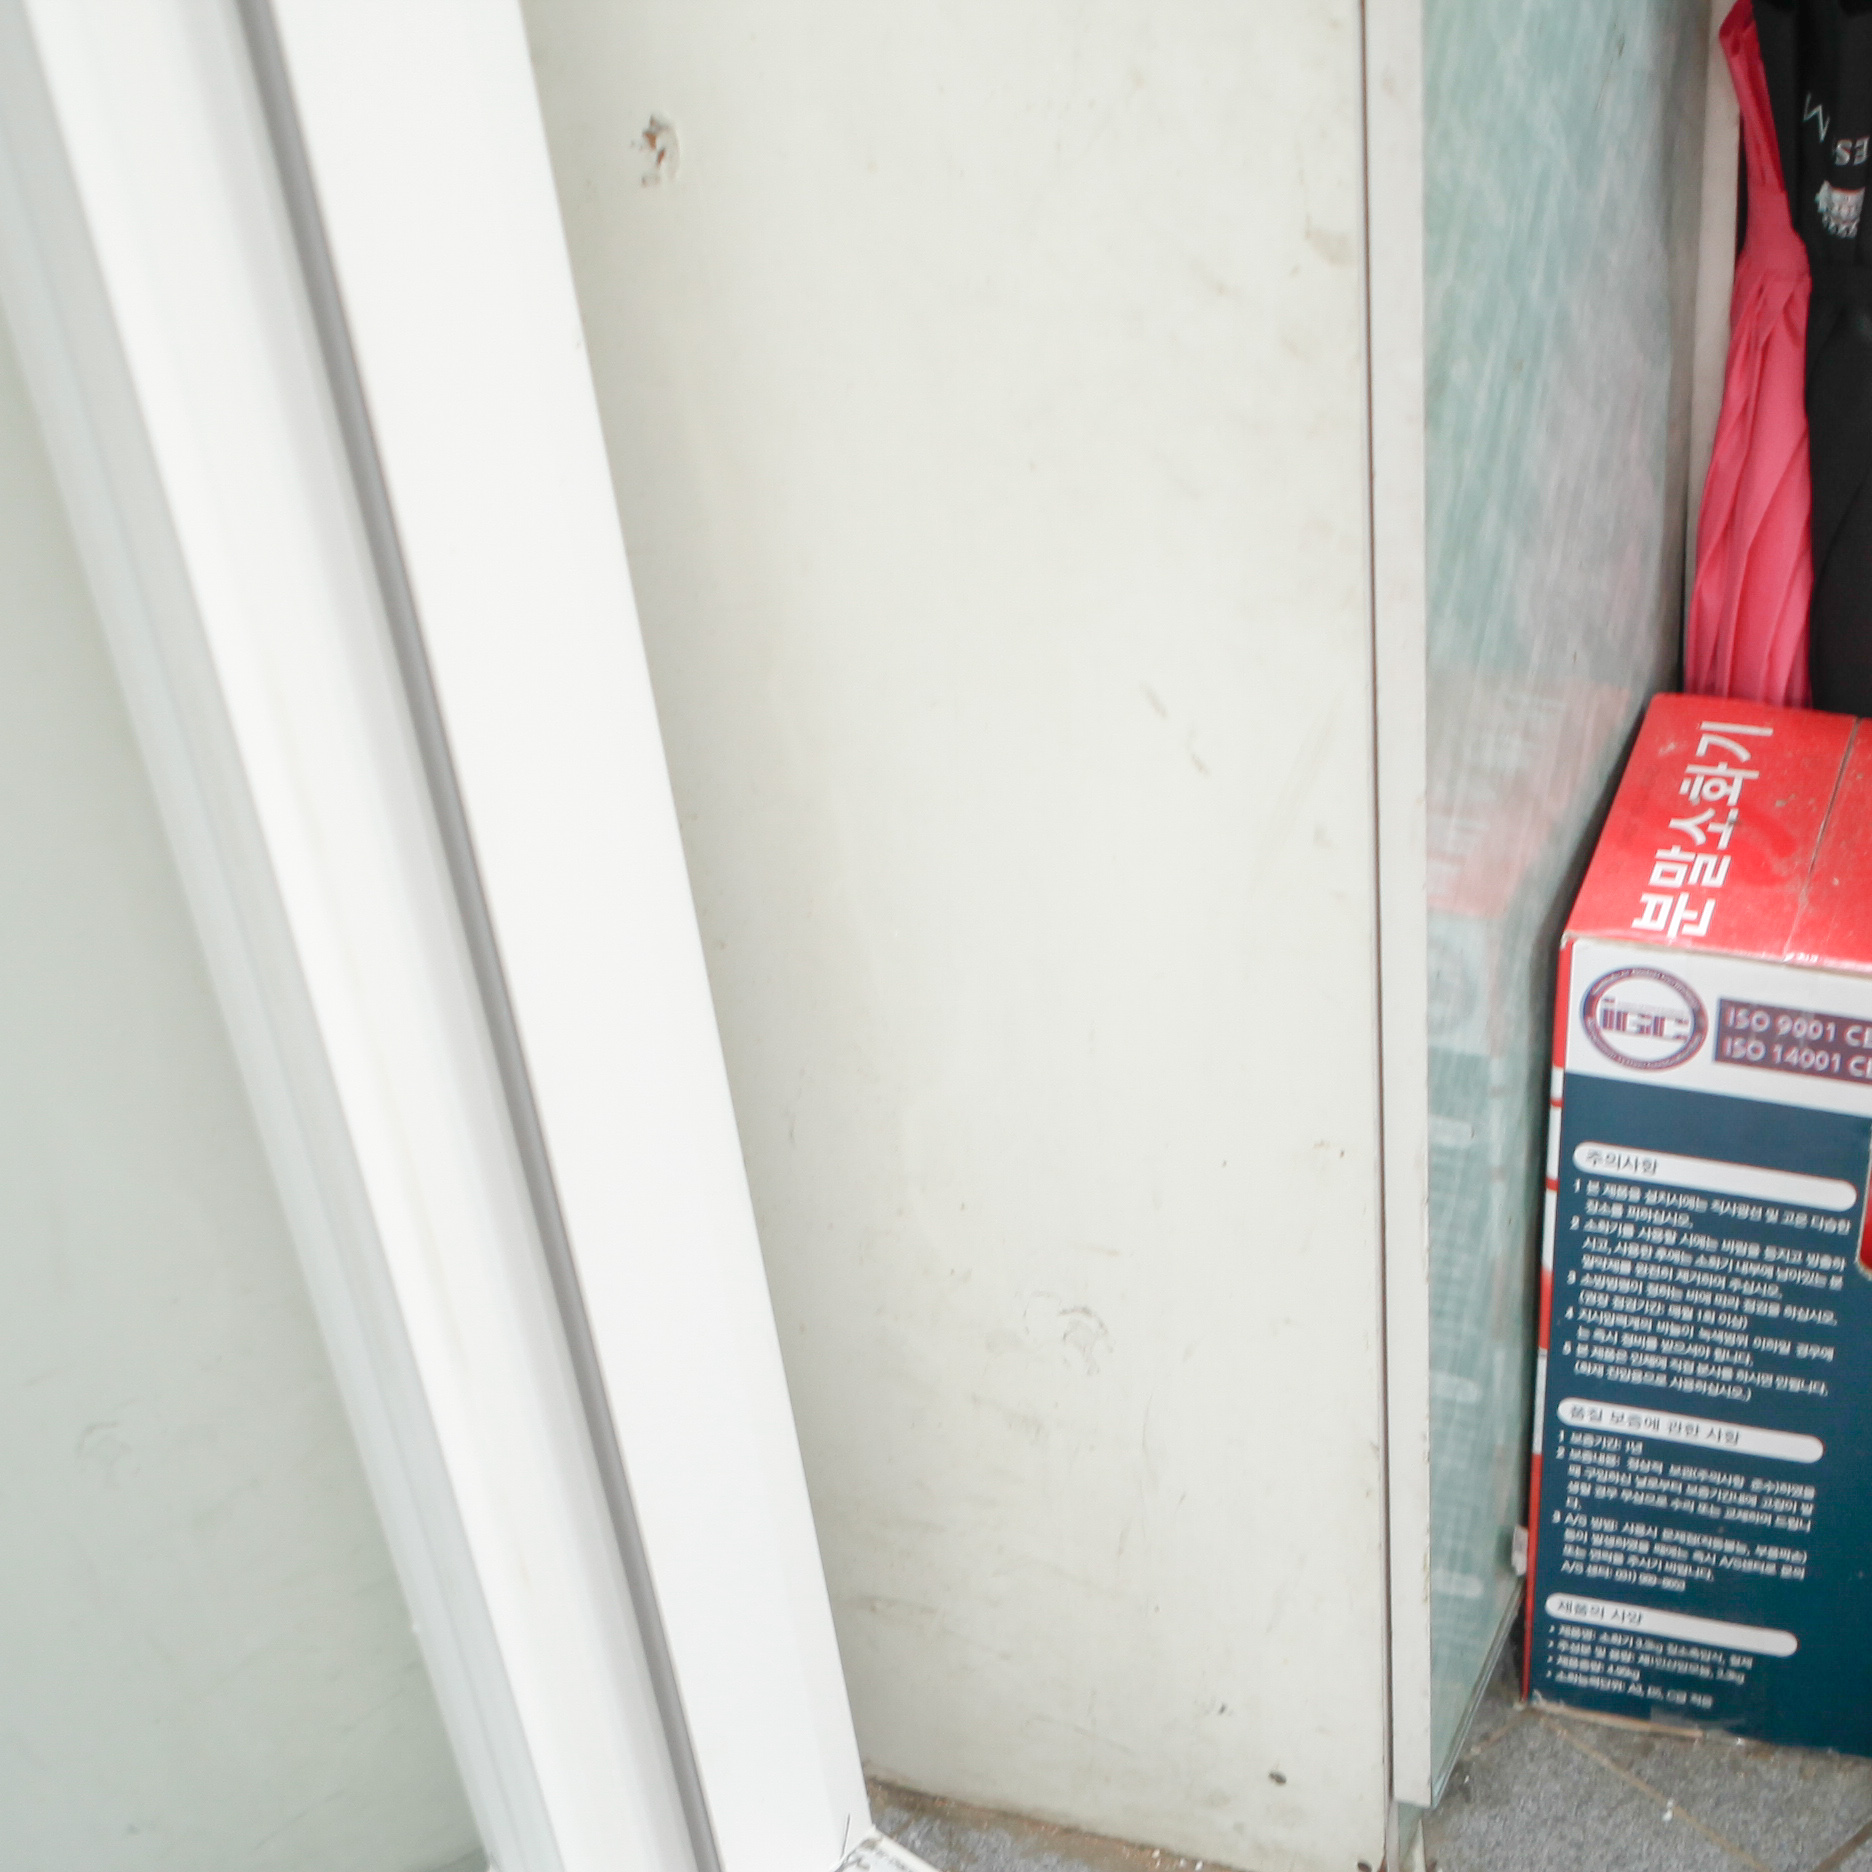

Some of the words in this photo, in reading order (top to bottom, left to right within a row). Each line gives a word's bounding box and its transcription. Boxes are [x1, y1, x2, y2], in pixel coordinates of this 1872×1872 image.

[1632, 720, 1774, 938] 분말소화기
[1728, 1006, 1770, 1034] ISO
[1776, 1012, 1837, 1047] 9001
[1723, 1034, 1767, 1063] ISO
[1772, 1041, 1842, 1075] 14001
